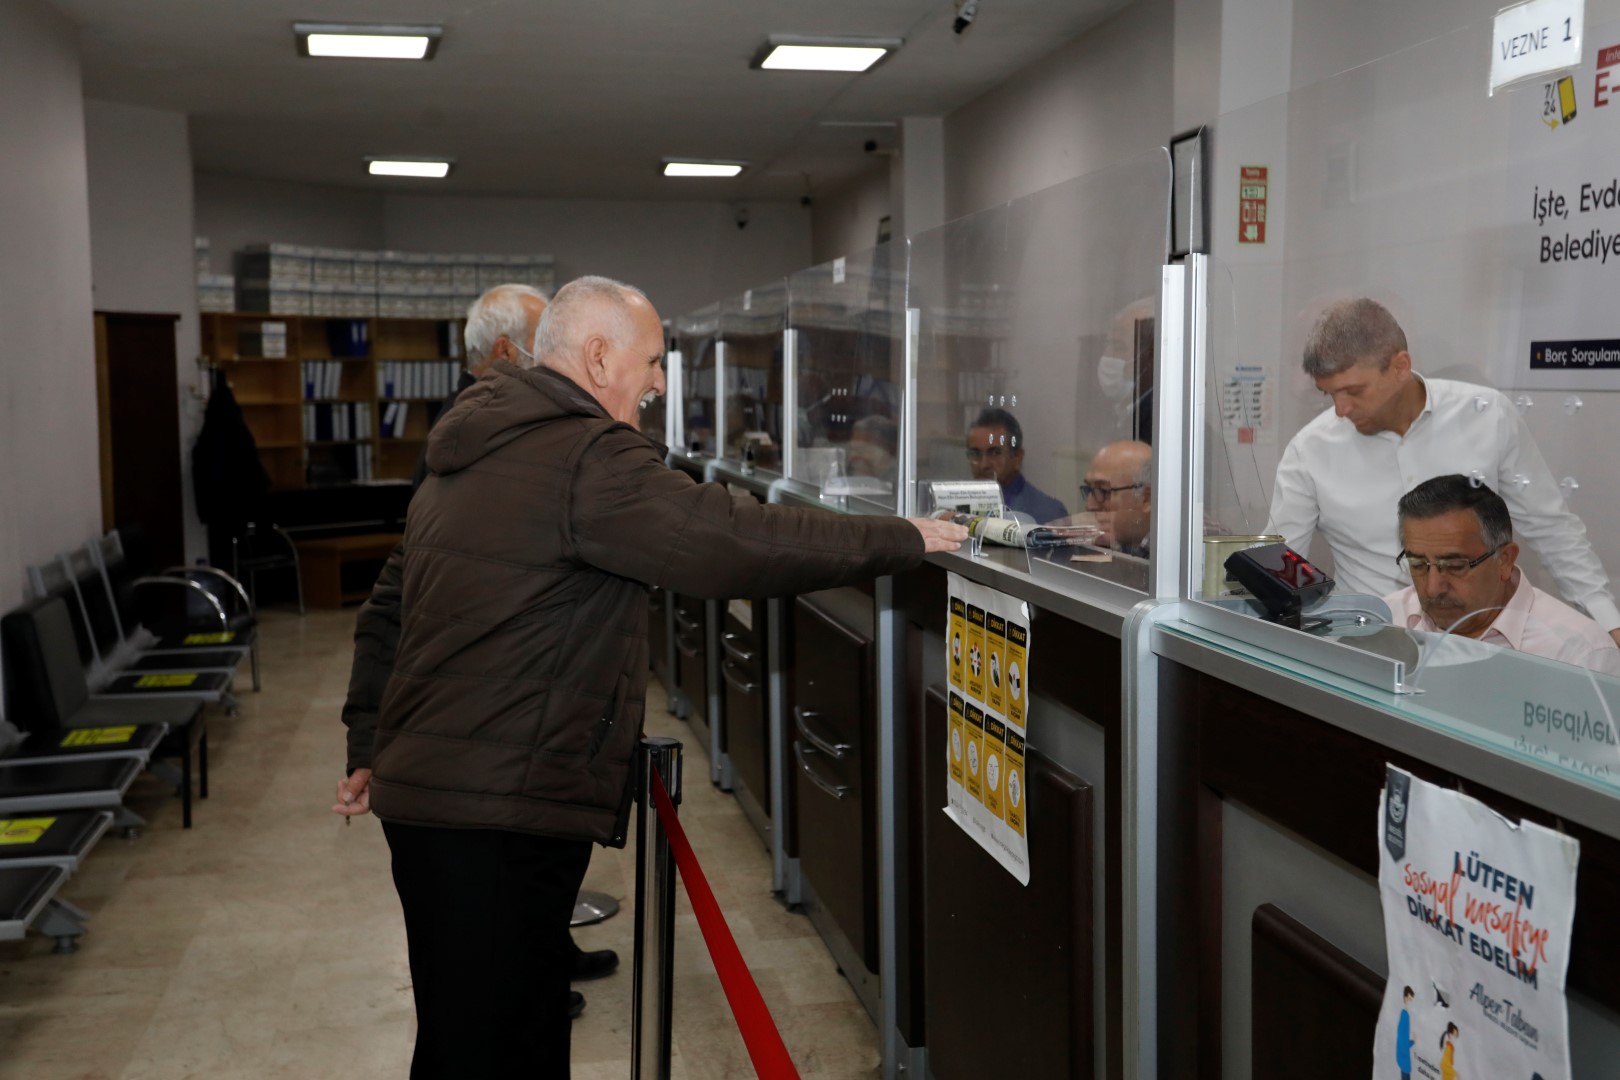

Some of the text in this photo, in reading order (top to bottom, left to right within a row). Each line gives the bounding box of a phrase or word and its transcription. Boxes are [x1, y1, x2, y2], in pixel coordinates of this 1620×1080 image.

[1501, 17, 1573, 61] VEZNE 1
[1543, 100, 1556, 116] 24
[1533, 178, 1620, 227] İşte, Evd
[1545, 348, 1567, 366] Borç
[1454, 850, 1535, 910] LÜTFEN
[1404, 862, 1549, 975] sosyal mesafeye
[1406, 894, 1539, 990] DİKKAT EDELİM
